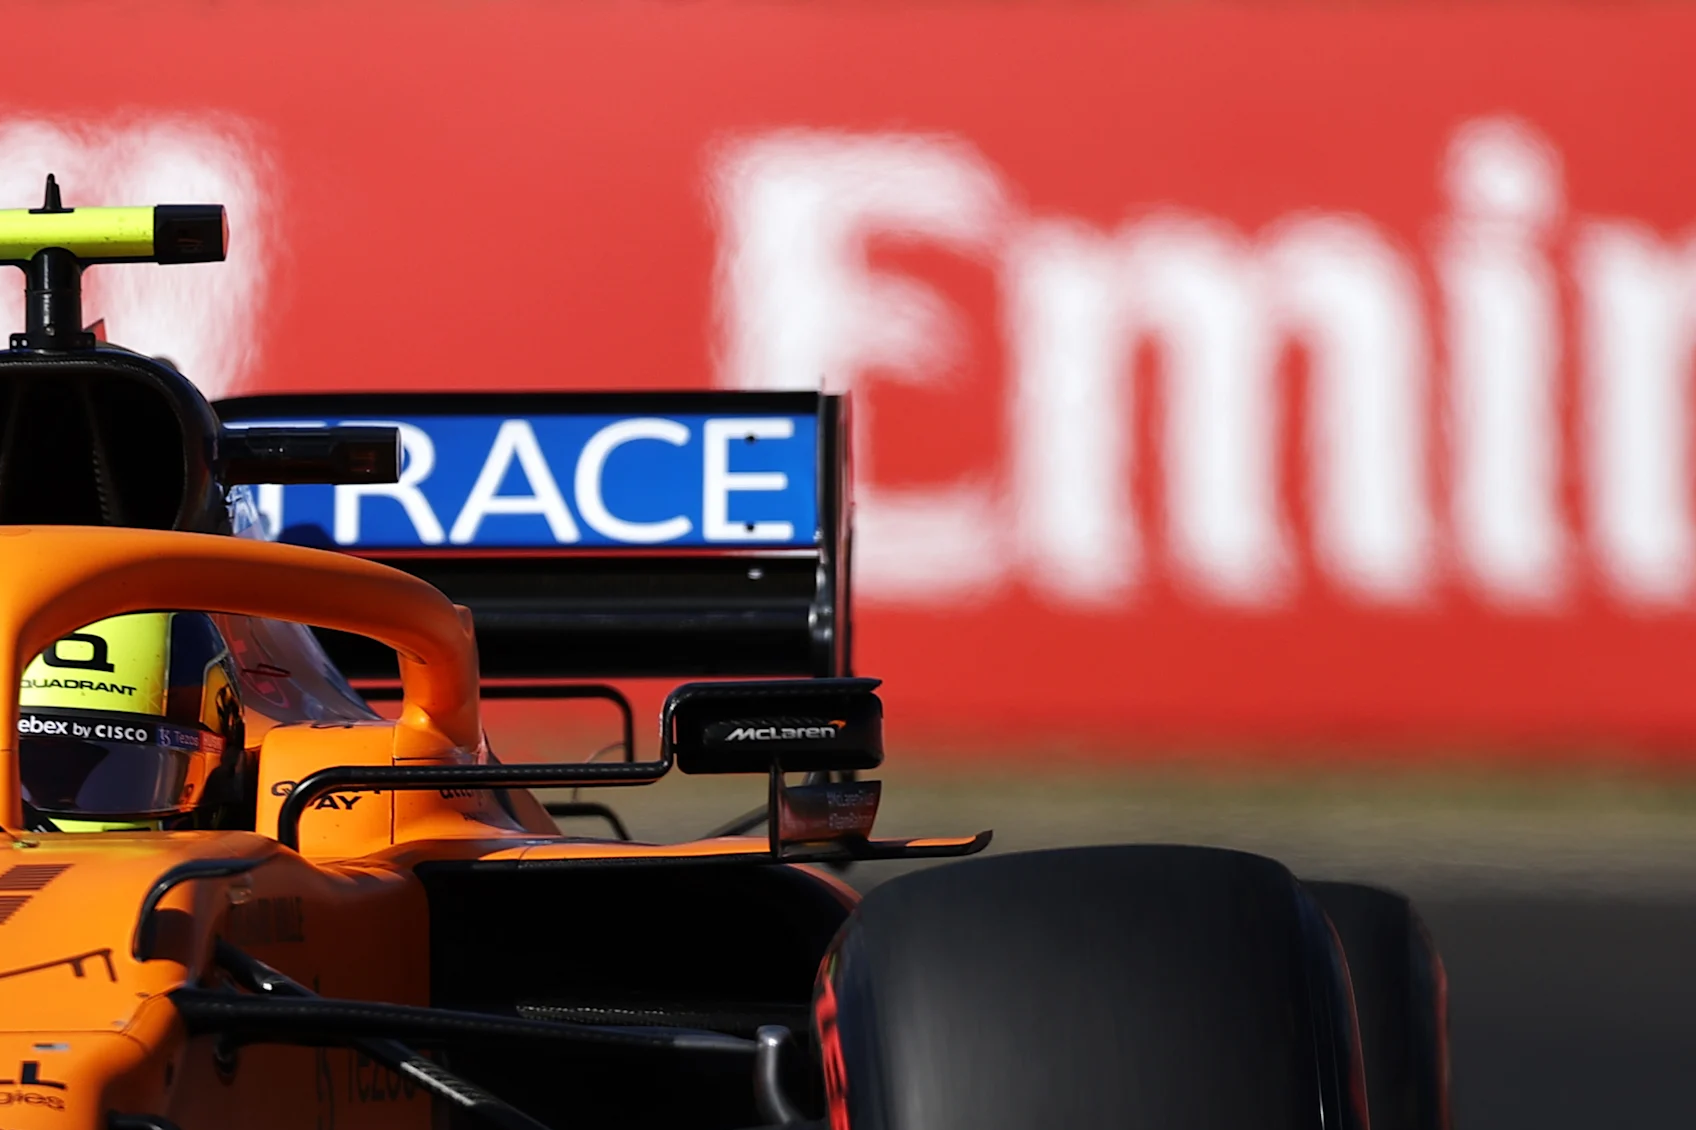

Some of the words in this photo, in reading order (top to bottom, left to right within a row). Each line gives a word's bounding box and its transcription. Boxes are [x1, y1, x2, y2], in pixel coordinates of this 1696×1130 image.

[20, 679, 137, 696] QUADRANT
[17, 715, 68, 734] ebex
[73, 723, 92, 738] by
[724, 726, 836, 741] McLaren
[307, 796, 363, 810] AY
